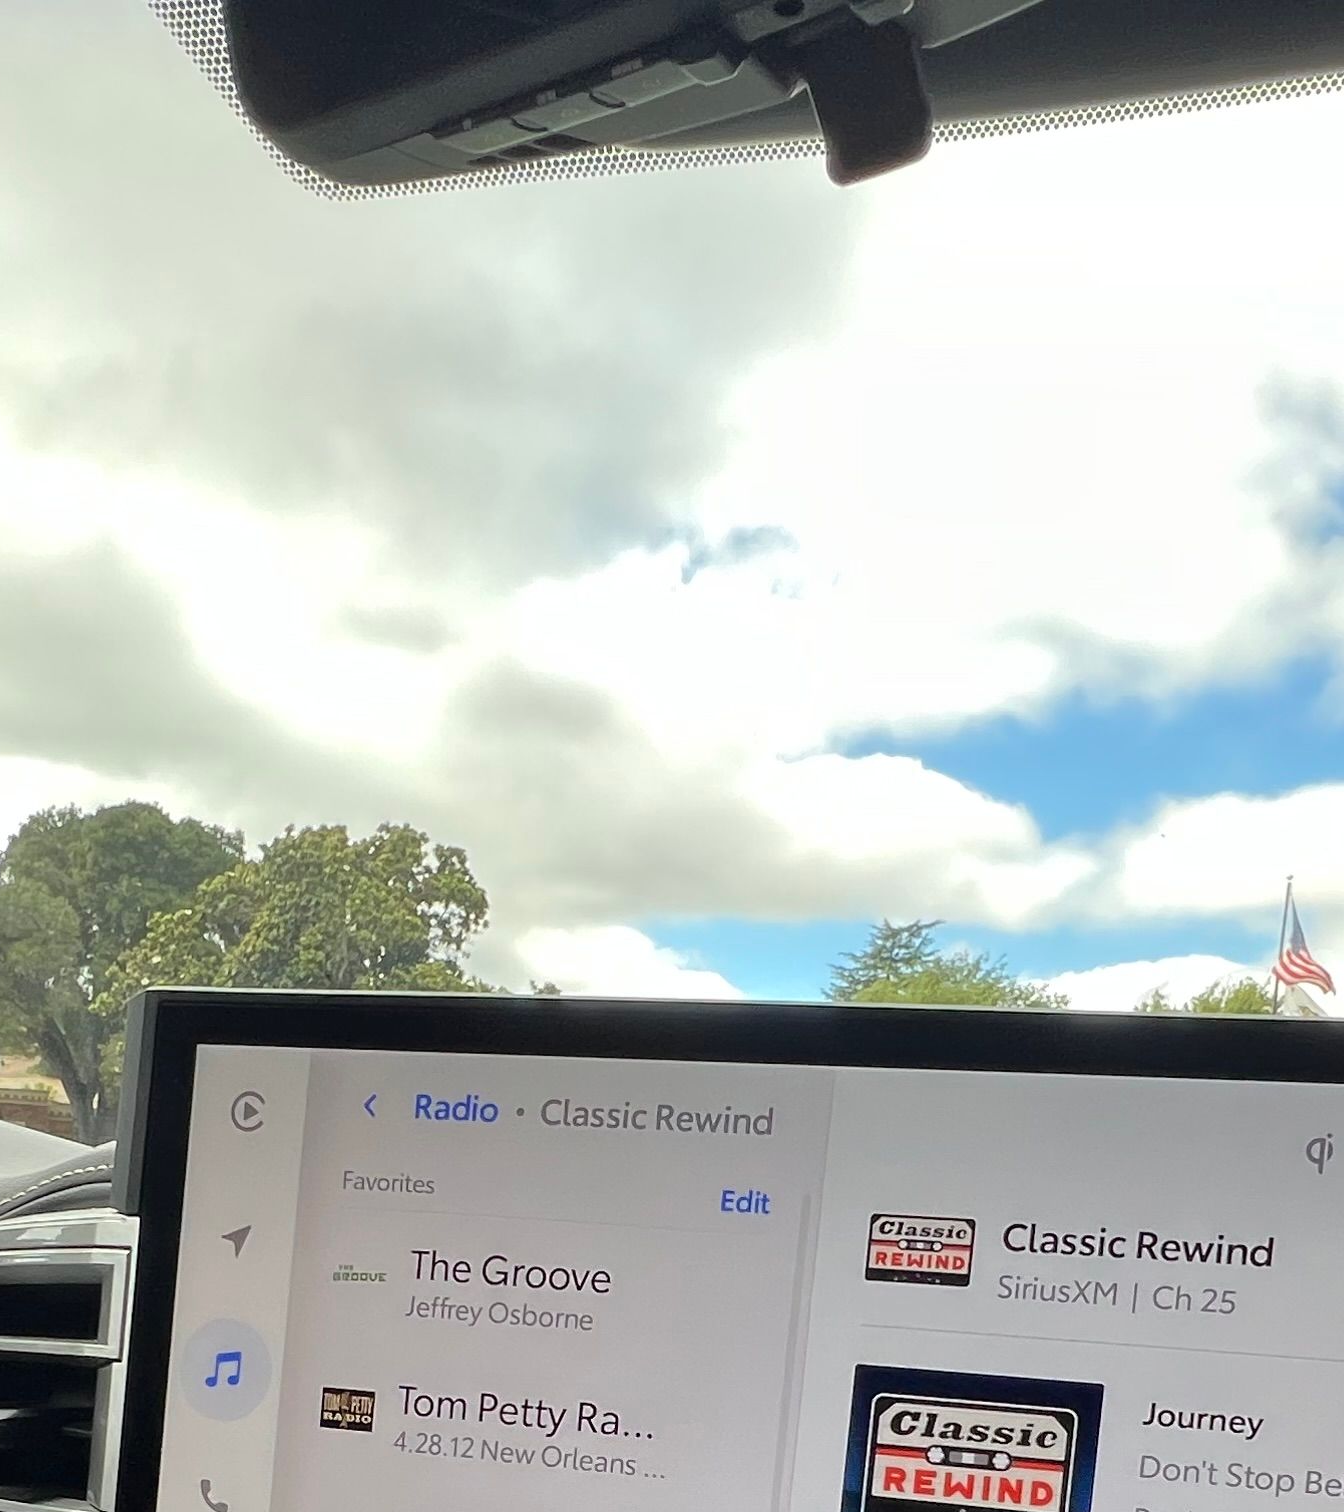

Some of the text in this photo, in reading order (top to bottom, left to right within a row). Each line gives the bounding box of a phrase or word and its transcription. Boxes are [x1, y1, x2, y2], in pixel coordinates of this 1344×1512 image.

[414, 1094, 775, 1138] Radio Classic Rewind
[342, 1170, 436, 1195] Favorites
[721, 1189, 771, 1216] Edit
[877, 1220, 969, 1243] Classic
[1002, 1223, 1274, 1269] Classic Rewind
[332, 1272, 387, 1282] GROOVE
[410, 1250, 612, 1294] The Groove
[874, 1250, 966, 1273] REWIND
[405, 1296, 594, 1332] Jeffrey Osborne
[998, 1274, 1120, 1308] SiriusXM
[1152, 1284, 1193, 1312] Ch
[1200, 1288, 1237, 1315] 25
[322, 1409, 373, 1425] RADIO
[399, 1385, 467, 1422] Tom
[479, 1391, 567, 1438] Petty
[890, 1409, 1058, 1450] Classic
[1142, 1403, 1264, 1441] Journey
[393, 1431, 475, 1460] 4.28.12
[481, 1439, 537, 1465] New
[542, 1444, 637, 1477] Orleans
[882, 1467, 1055, 1508] REWIND
[1138, 1454, 1217, 1488] Don't
[1226, 1460, 1298, 1500] Stop
